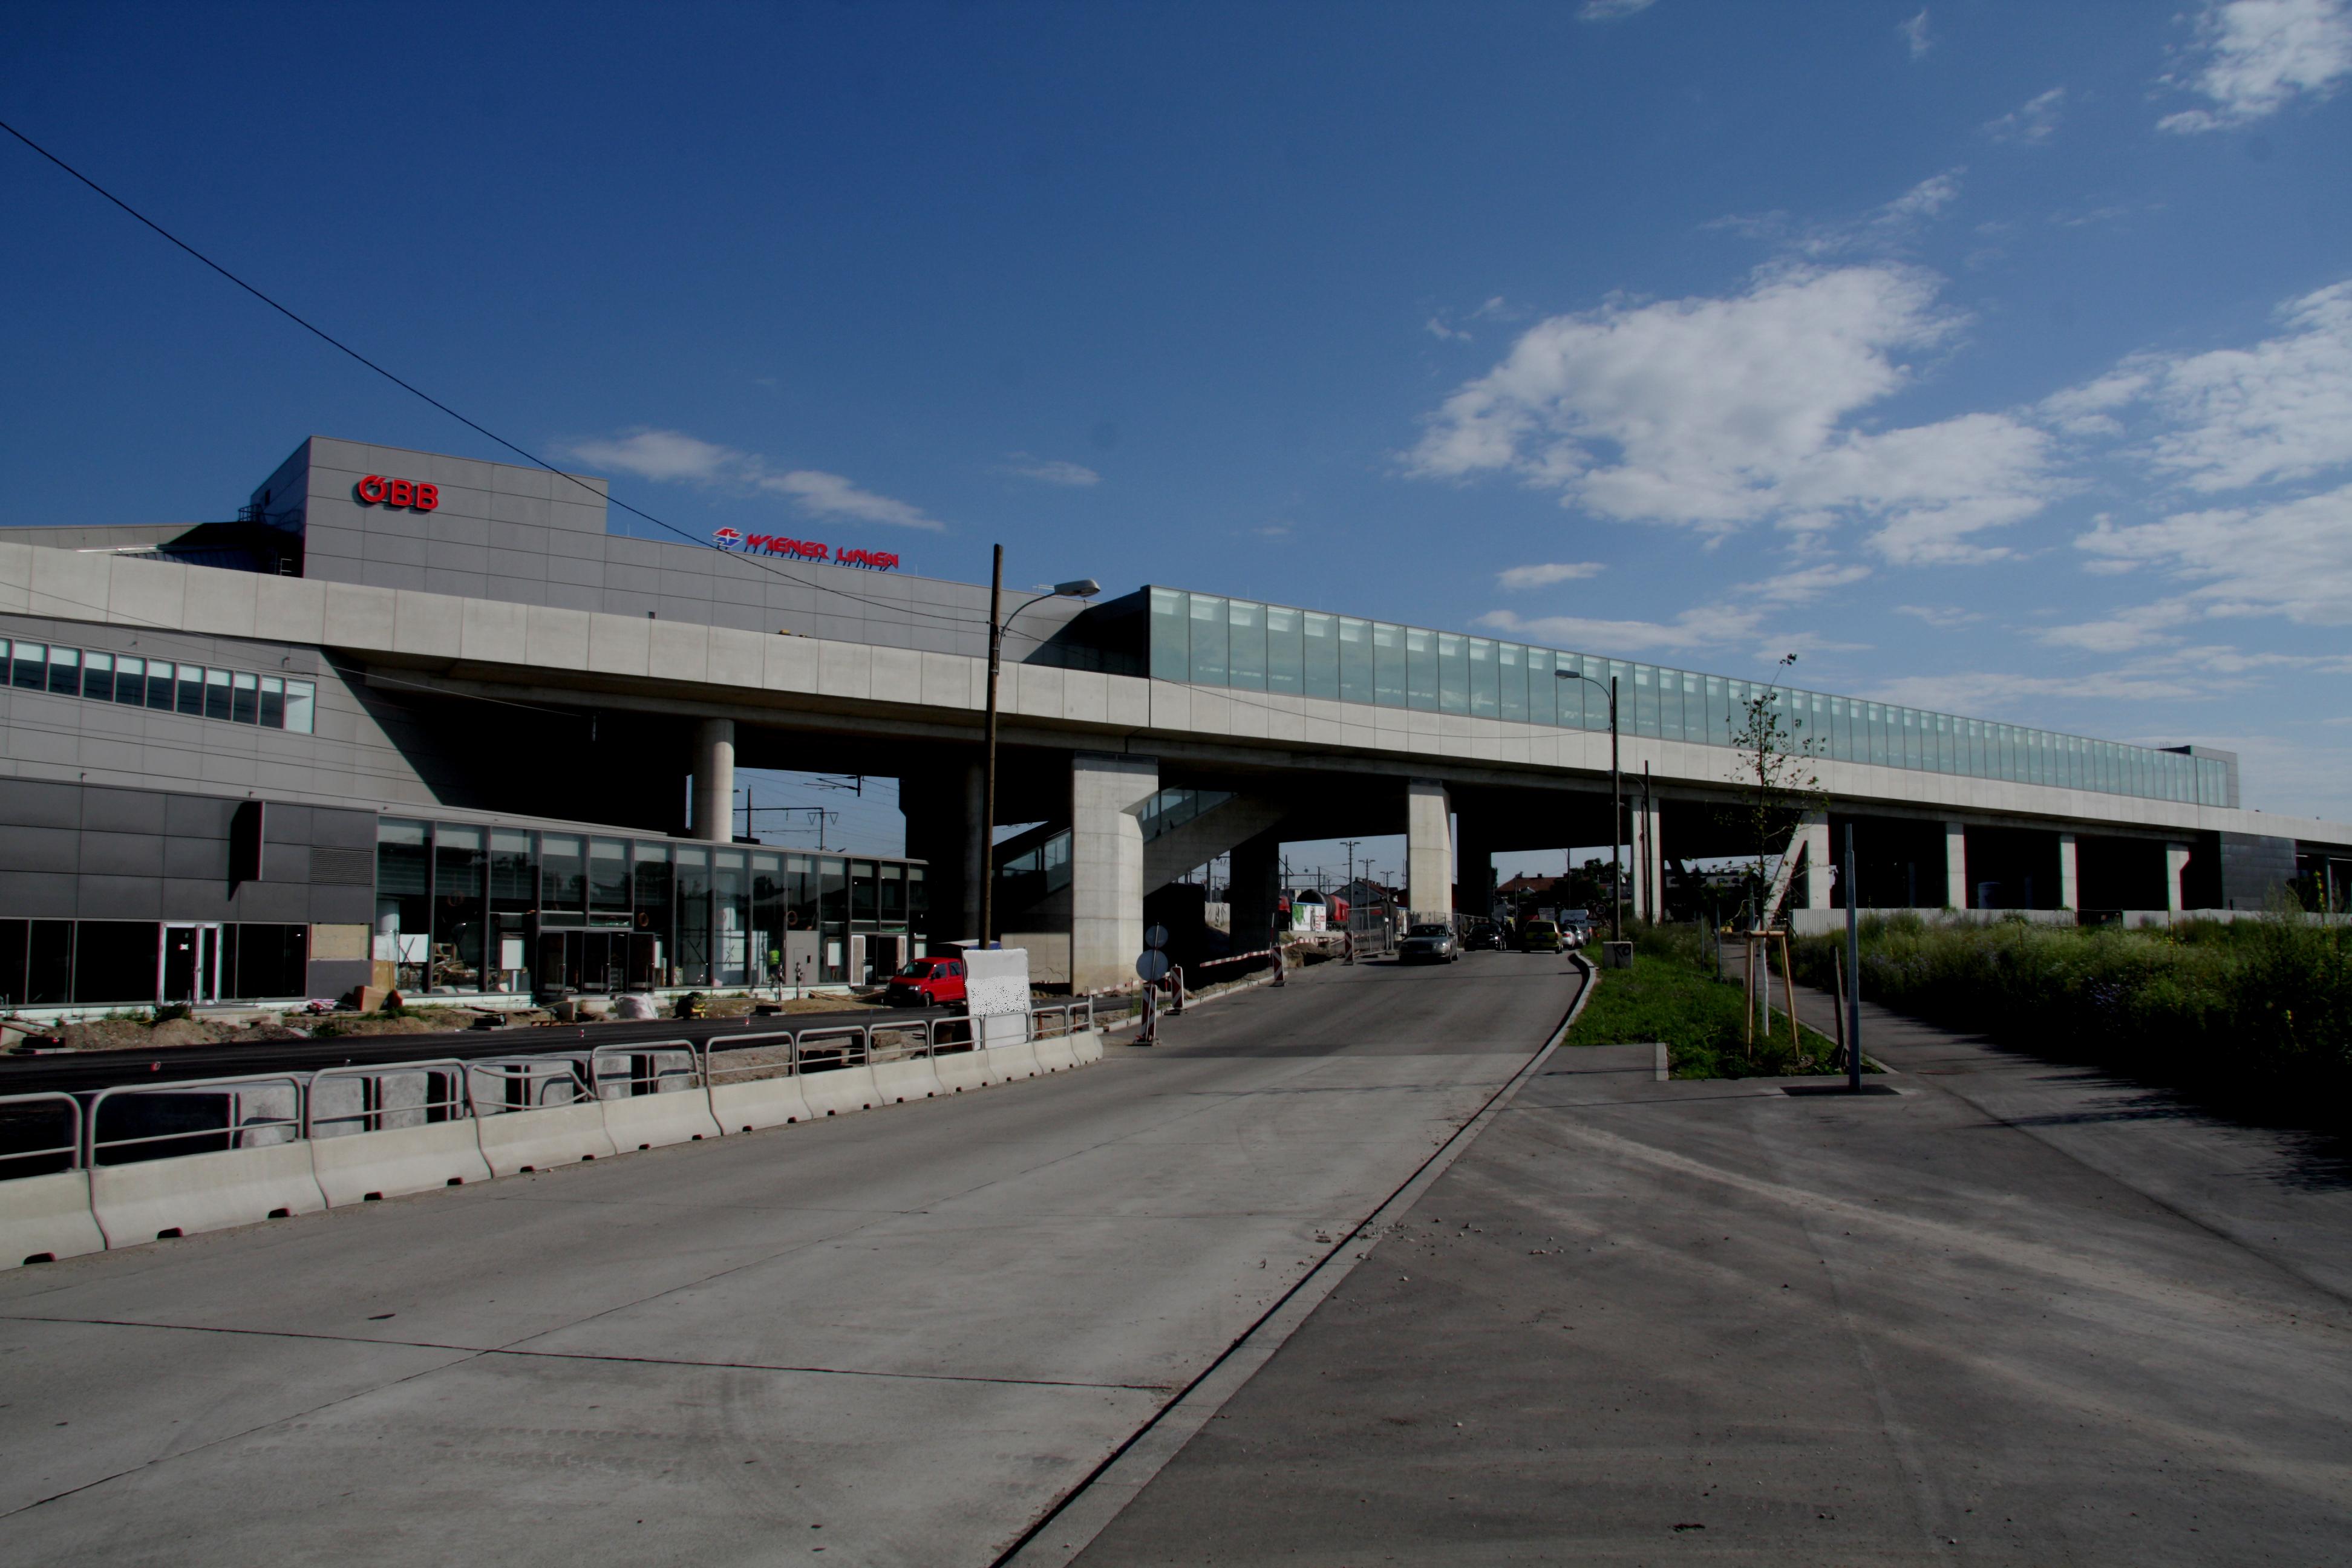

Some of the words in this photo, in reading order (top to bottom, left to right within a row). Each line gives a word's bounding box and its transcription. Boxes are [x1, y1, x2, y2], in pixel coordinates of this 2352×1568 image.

[358, 475, 439, 511] ÖBB
[746, 534, 829, 560] WIENER
[837, 547, 899, 569] LINIEN
